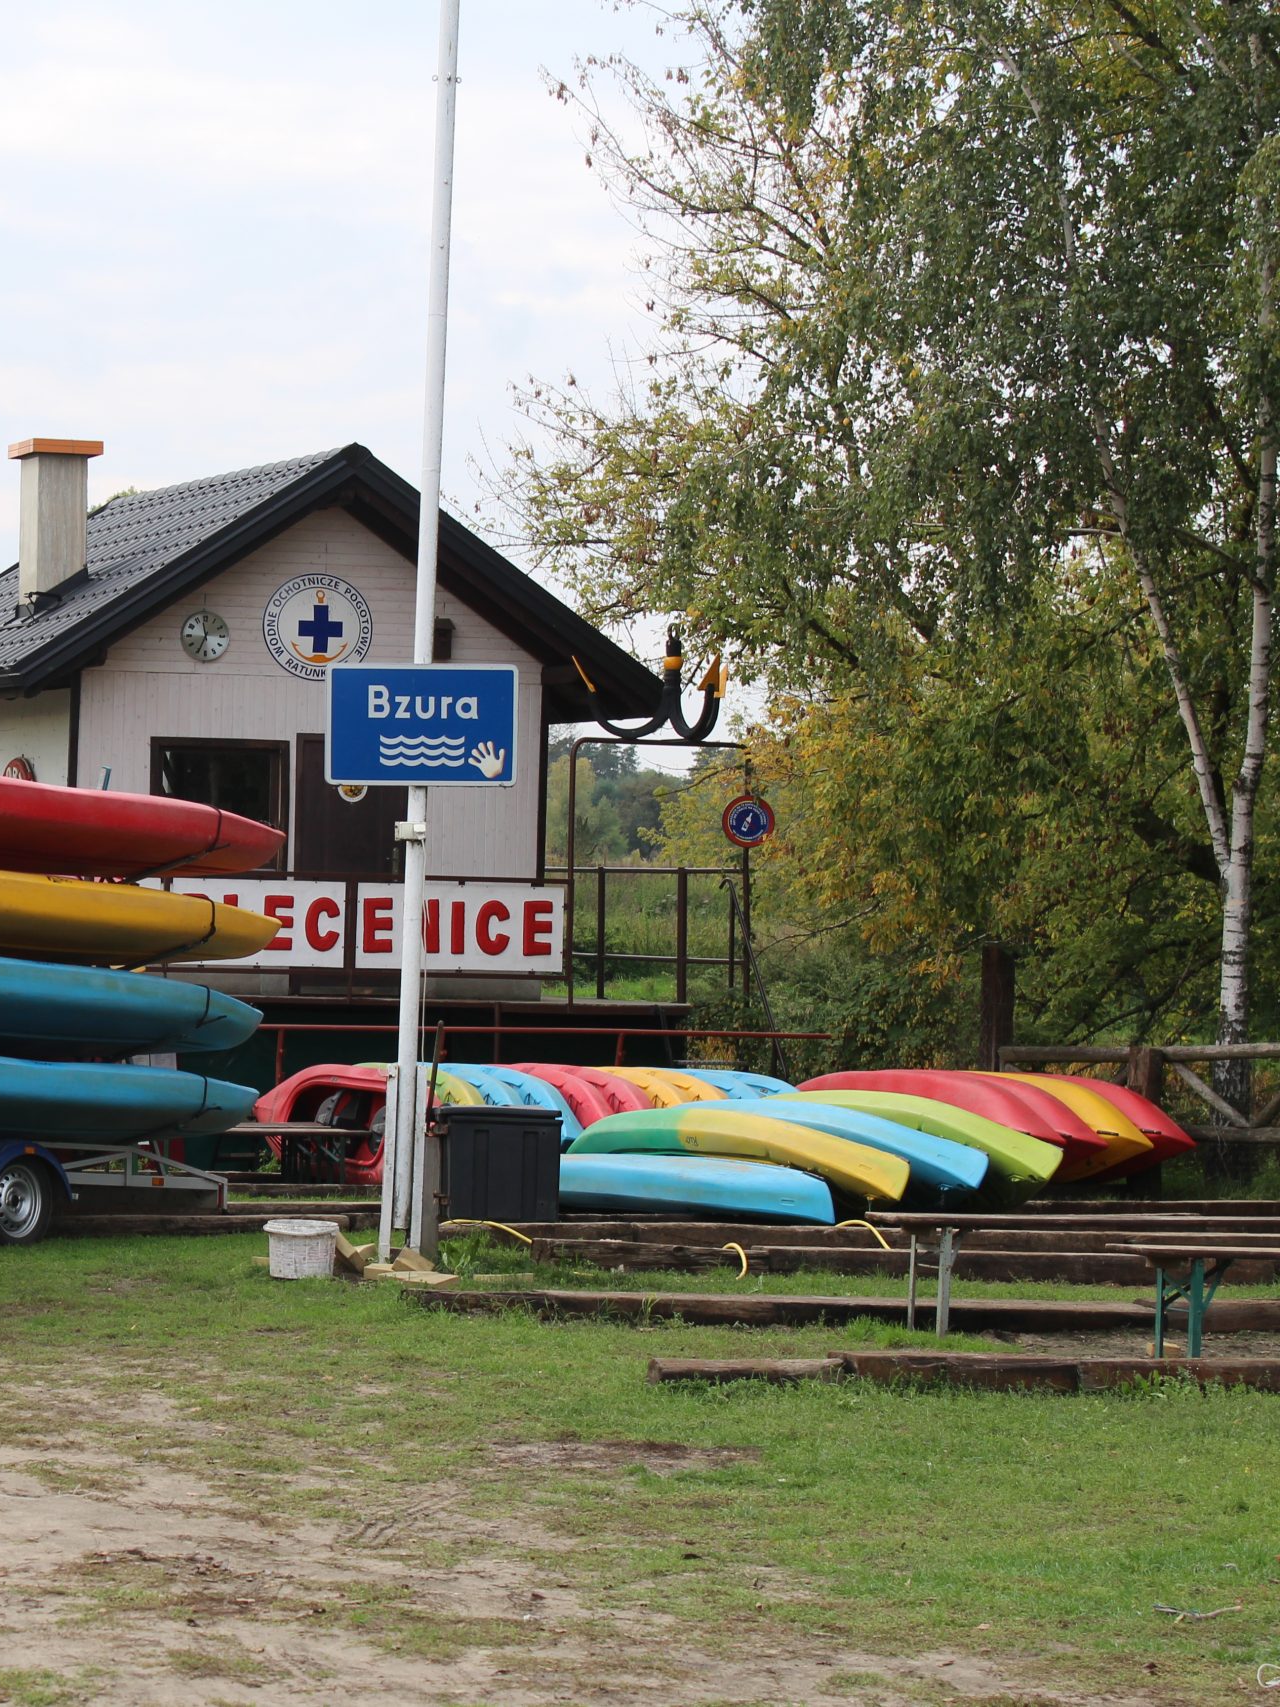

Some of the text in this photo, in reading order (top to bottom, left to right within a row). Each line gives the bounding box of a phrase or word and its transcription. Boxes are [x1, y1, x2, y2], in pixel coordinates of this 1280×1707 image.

[273, 577, 340, 608] OCHOTNICZE
[266, 611, 284, 658] WODNE
[344, 587, 370, 658] POGOTOWIE
[367, 684, 479, 720] Bzura
